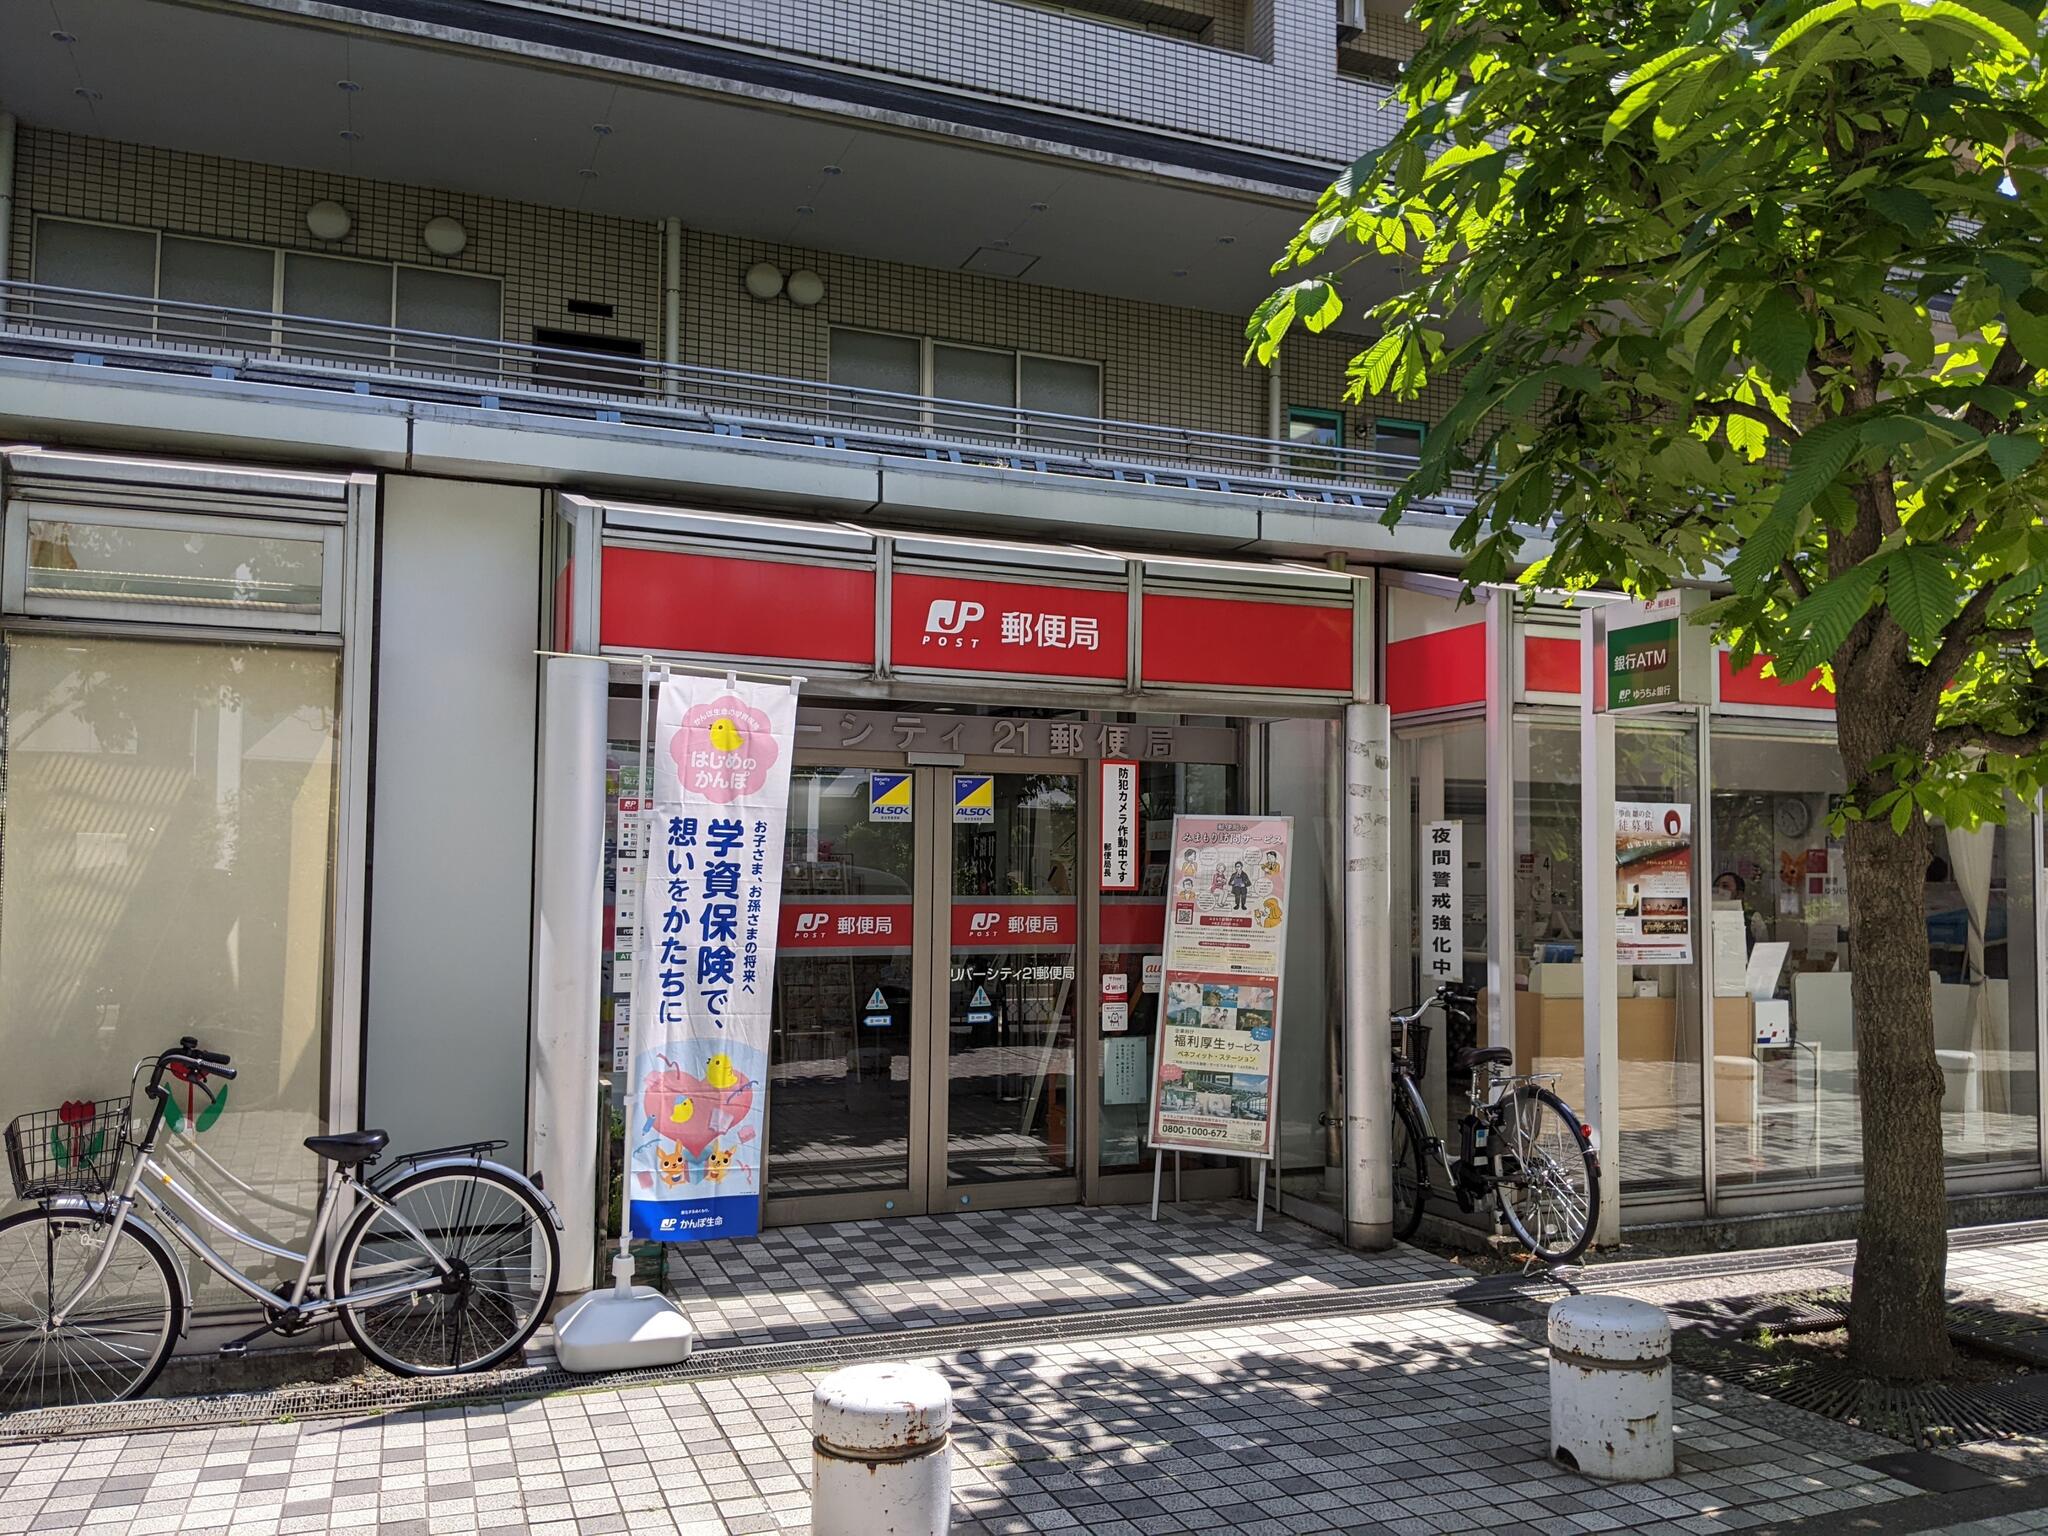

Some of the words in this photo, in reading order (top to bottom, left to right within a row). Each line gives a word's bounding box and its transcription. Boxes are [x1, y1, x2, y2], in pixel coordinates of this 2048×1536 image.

[1000, 611, 1099, 651] 郵便局
[922, 635, 980, 649] POST
[1614, 648, 1666, 672] 銀行ATM
[1633, 685, 1671, 699] ゆうちょ銀行
[691, 751, 757, 770] はじめの
[695, 770, 751, 789] かんぽ
[872, 806, 909, 815] ALSOK
[956, 807, 991, 816] ALSOK
[1118, 767, 1129, 883] 防犯カメラ作動中です
[1182, 832, 1283, 845] みまもり訪問サービス
[1103, 843, 1112, 878] 郵便局長
[742, 820, 768, 995] お子さま、お孫さまの将来へ
[1432, 827, 1452, 975] 夜間警戒強化中
[658, 816, 698, 1024] 想いをかたちに
[697, 818, 745, 1029] 学資保険で、
[837, 916, 892, 935] 郵便局
[1008, 916, 1058, 934] 郵便局
[950, 966, 1075, 982] リバーシティ21郵便局
[1174, 1034, 1261, 1053] 福利厚生サービス
[1162, 1124, 1228, 1138] 0800-1000-672
[680, 1216, 723, 1229] かんぽ生命
